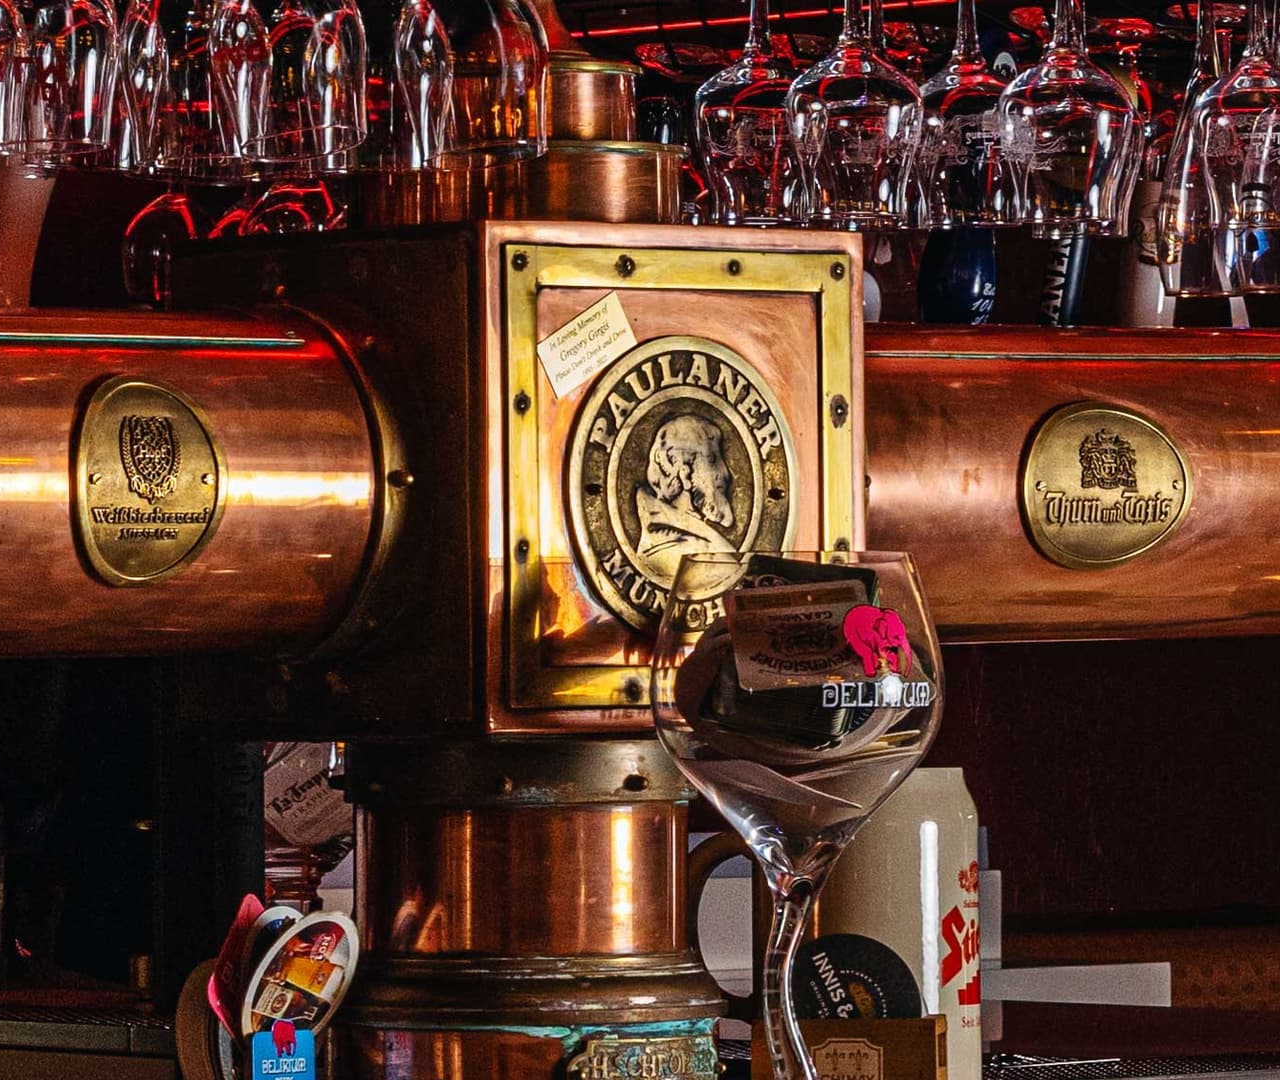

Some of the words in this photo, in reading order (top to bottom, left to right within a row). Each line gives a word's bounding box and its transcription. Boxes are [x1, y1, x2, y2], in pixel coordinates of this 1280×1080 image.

[1037, 236, 1072, 325] ANER
[577, 311, 601, 333] Memory
[589, 353, 782, 460] PAULANER
[91, 506, 211, 524] Weißbierbrauerei
[1043, 490, 1101, 528] Thurn
[1102, 500, 1123, 524] und
[1121, 490, 1173, 526] Taxis
[602, 549, 727, 630] MÜNCH
[750, 648, 854, 674] evensteiner
[285, 766, 331, 802] Trapp
[811, 951, 846, 1002] INNIS
[836, 1002, 854, 1019] &
[261, 1057, 307, 1074] DELIRIUM
